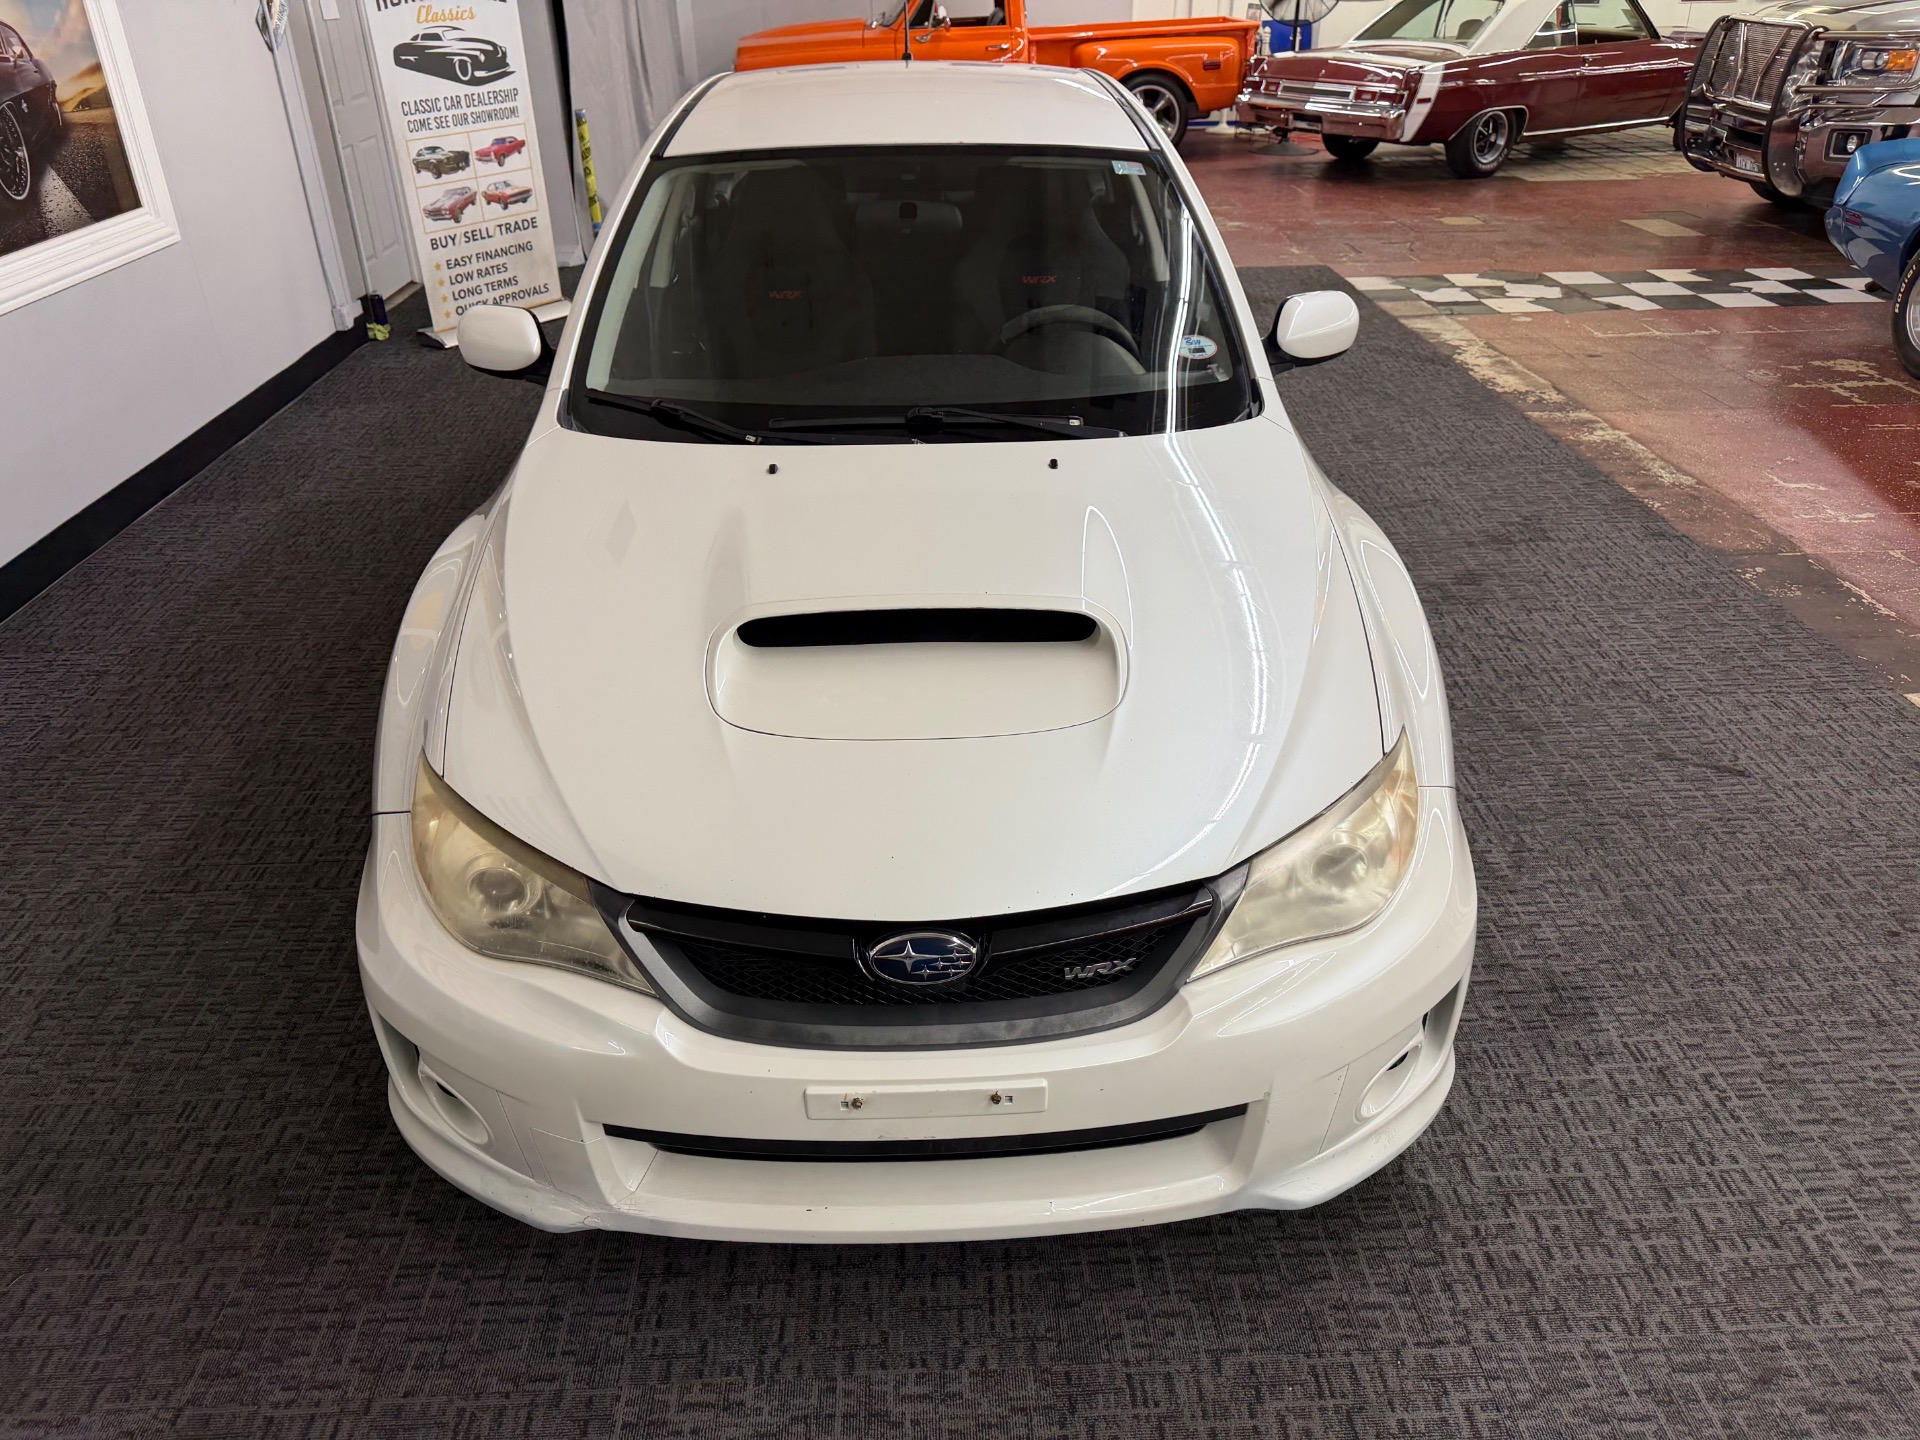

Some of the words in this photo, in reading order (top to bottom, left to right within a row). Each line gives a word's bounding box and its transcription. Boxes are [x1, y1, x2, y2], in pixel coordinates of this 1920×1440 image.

[416, 5, 476, 24] Classics
[401, 97, 442, 116] CLASSIC
[443, 94, 463, 111] CAR
[464, 87, 519, 108] DEALERSHIP
[407, 117, 433, 133] COME
[434, 115, 451, 129] SEE
[452, 112, 470, 127] OUR
[470, 105, 520, 125] SHOWROOM!
[446, 254, 473, 270] EASY
[475, 241, 533, 263] FINANCING
[449, 271, 474, 286] LOW
[476, 262, 509, 279] RATES
[1022, 275, 1057, 284] WRX
[452, 285, 483, 301] LONG
[484, 275, 519, 293] TERMS
[492, 283, 550, 305] APPROVALS
[768, 289, 802, 299] WRX
[1064, 957, 1137, 980] WRX
